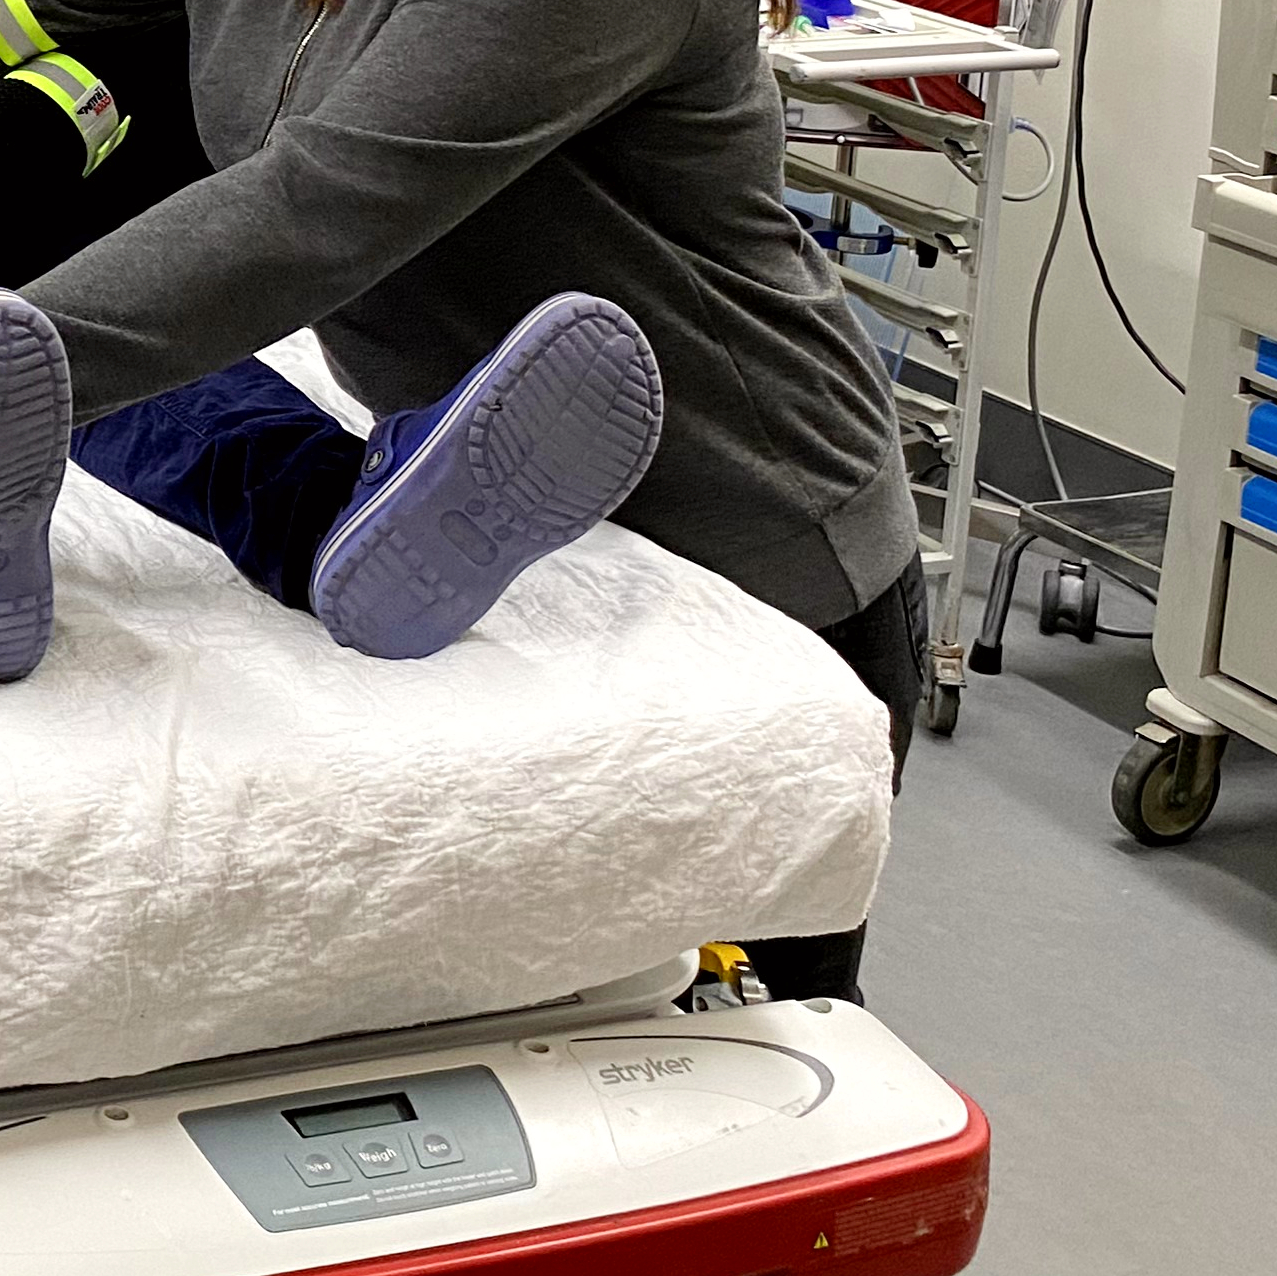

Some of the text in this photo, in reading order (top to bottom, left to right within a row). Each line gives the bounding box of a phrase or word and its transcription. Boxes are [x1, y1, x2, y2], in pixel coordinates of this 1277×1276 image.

[599, 1057, 695, 1085] stryker
[358, 1147, 397, 1163] Weigh
[426, 1143, 448, 1154] Zero
